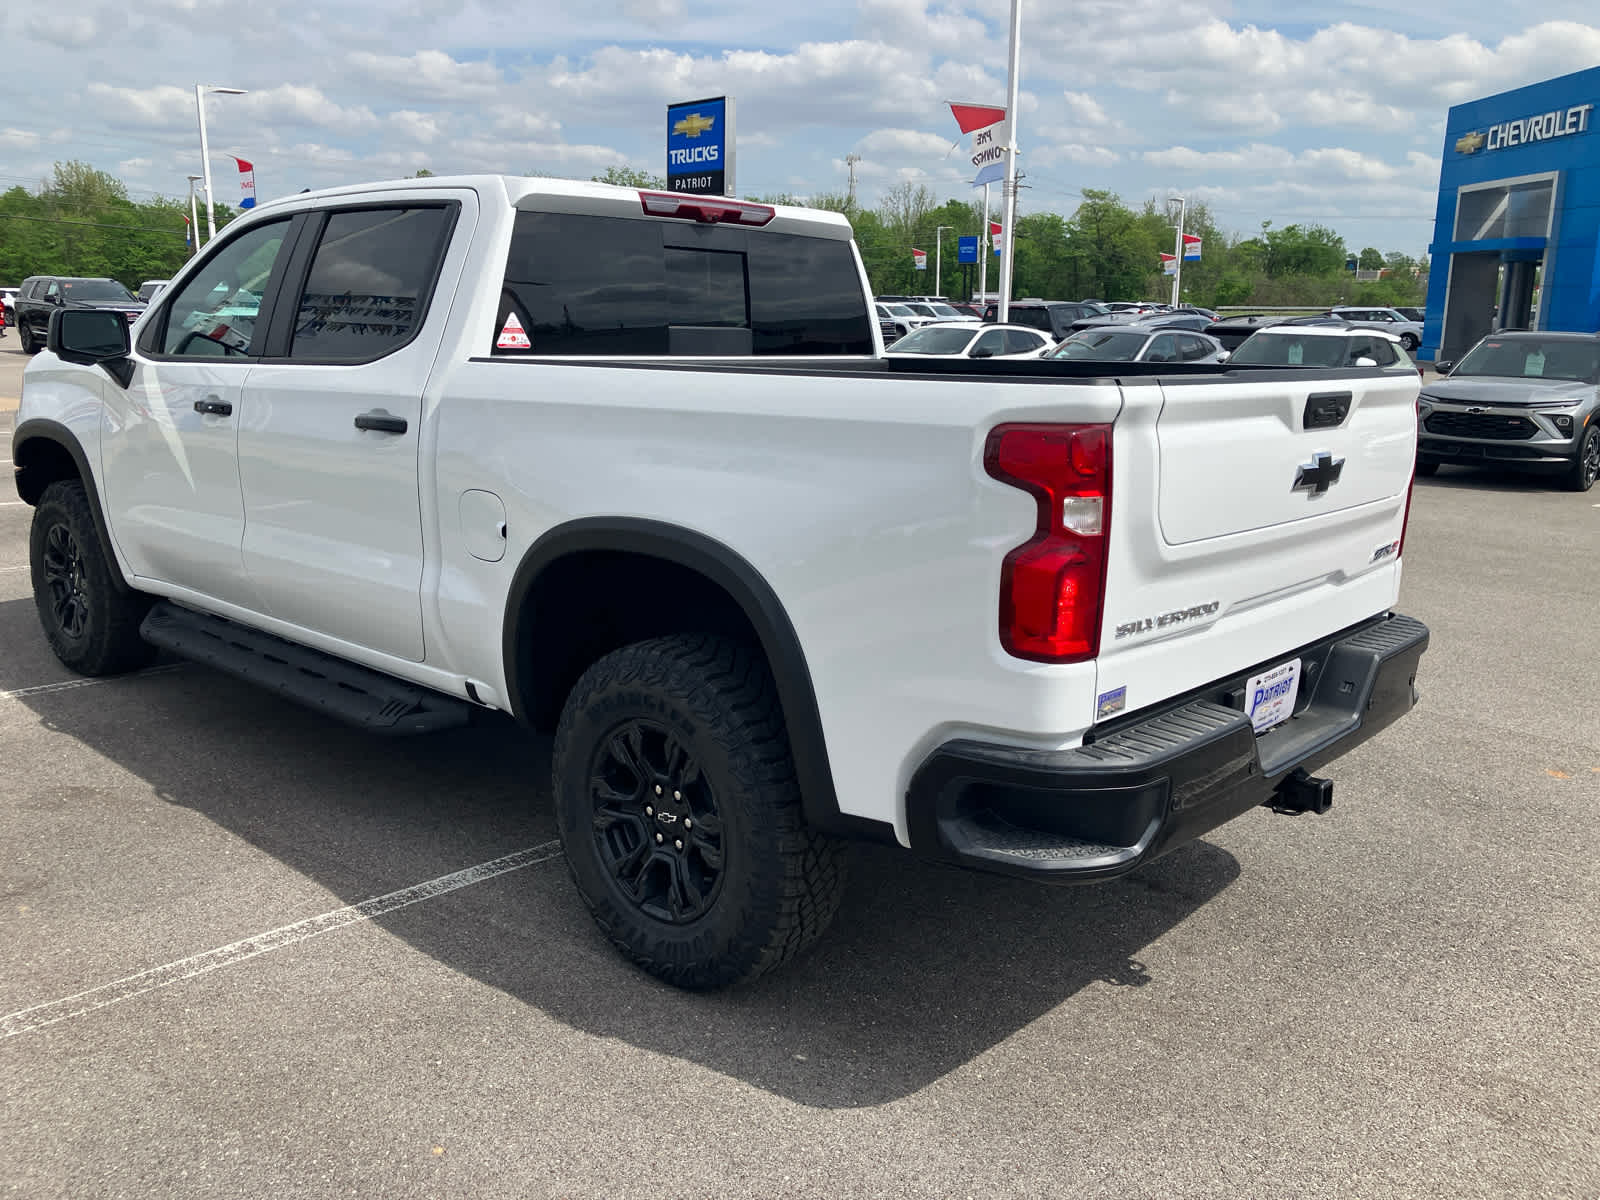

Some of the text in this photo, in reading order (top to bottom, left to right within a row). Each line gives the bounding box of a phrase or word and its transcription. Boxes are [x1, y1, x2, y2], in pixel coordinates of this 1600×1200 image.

[1487, 104, 1593, 150] CHEVROLET
[669, 145, 718, 165] TRUCKS
[675, 176, 713, 190] PATRIOT
[1115, 601, 1220, 640] SILVERADO
[1250, 676, 1294, 718] PATRIOT
